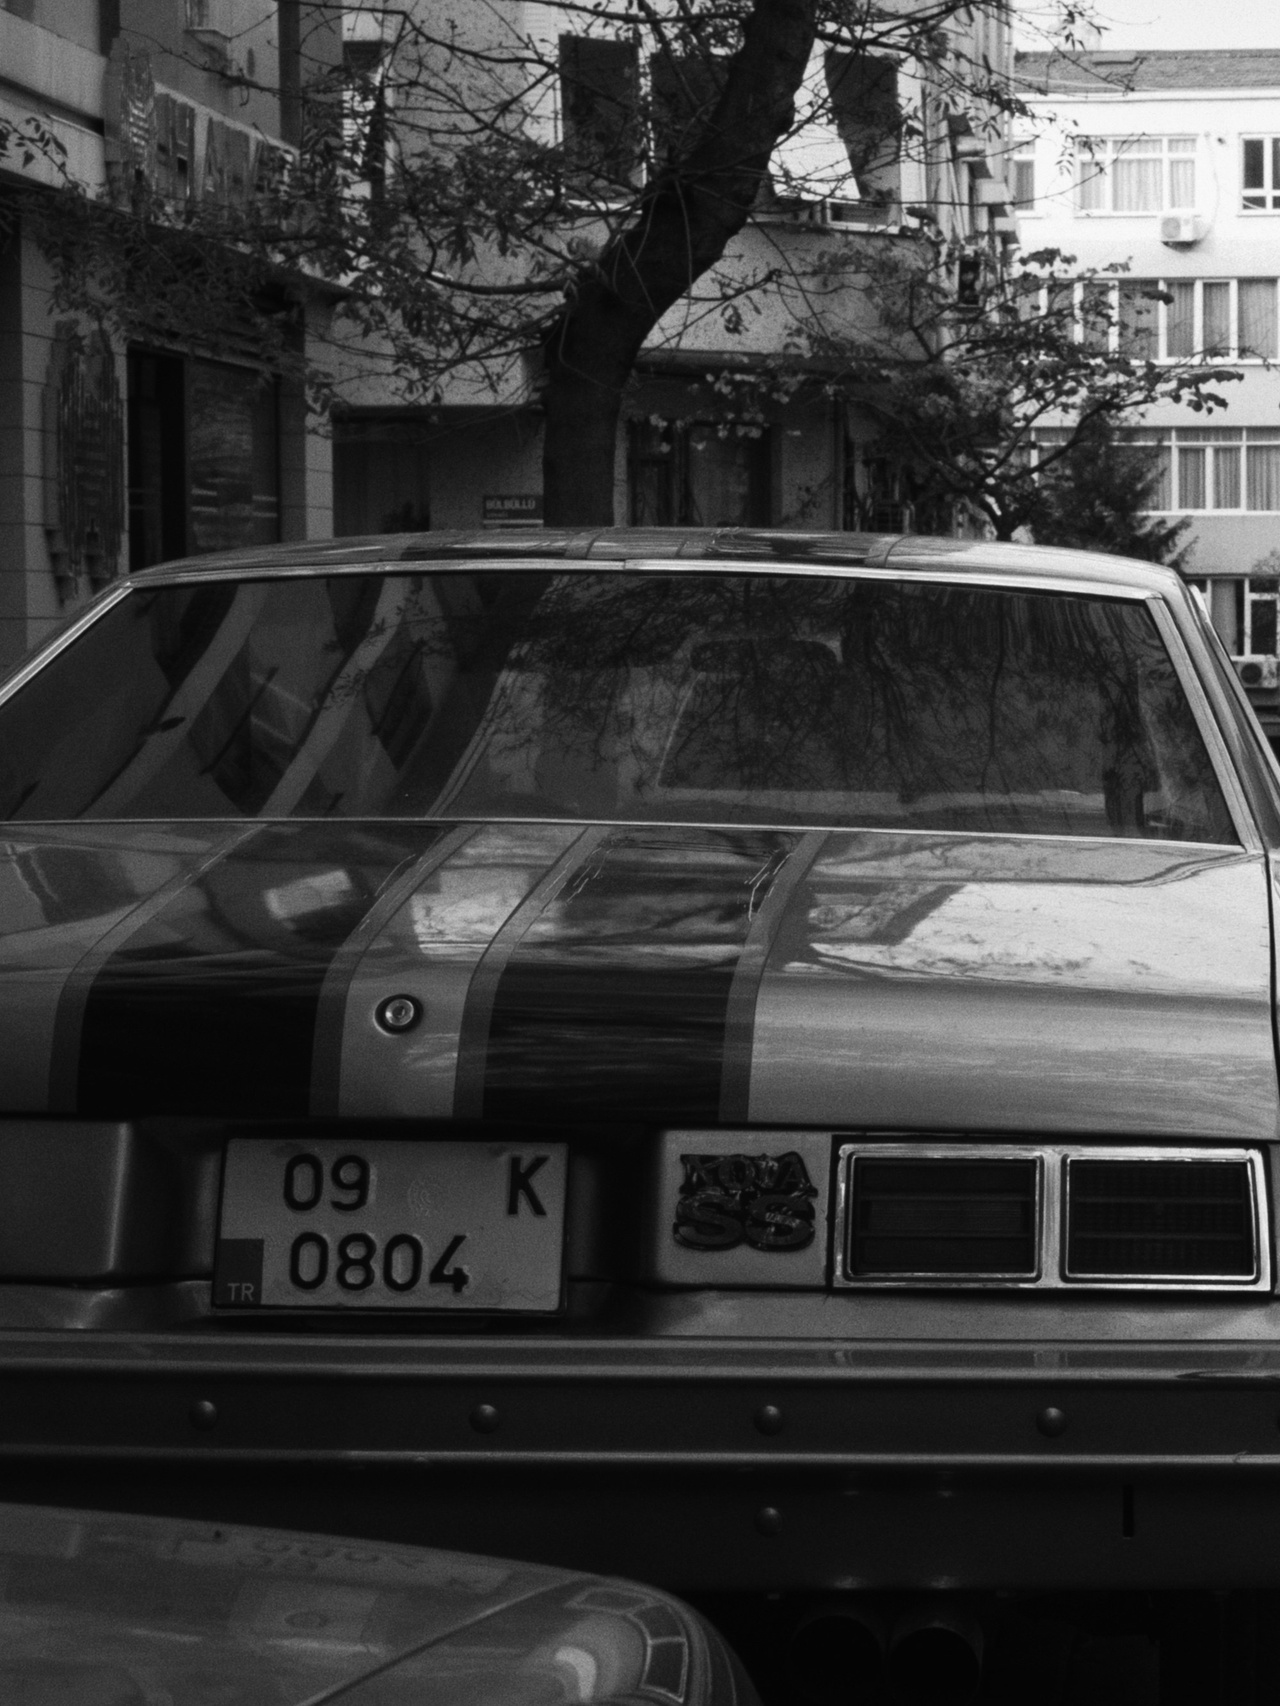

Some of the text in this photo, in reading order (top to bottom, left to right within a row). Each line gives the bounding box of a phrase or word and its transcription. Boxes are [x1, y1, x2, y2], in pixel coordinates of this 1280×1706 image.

[283, 1153, 549, 1217] 09 K
[673, 1194, 816, 1253] SS
[227, 1283, 255, 1302] TR
[289, 1231, 470, 1294] 0804
